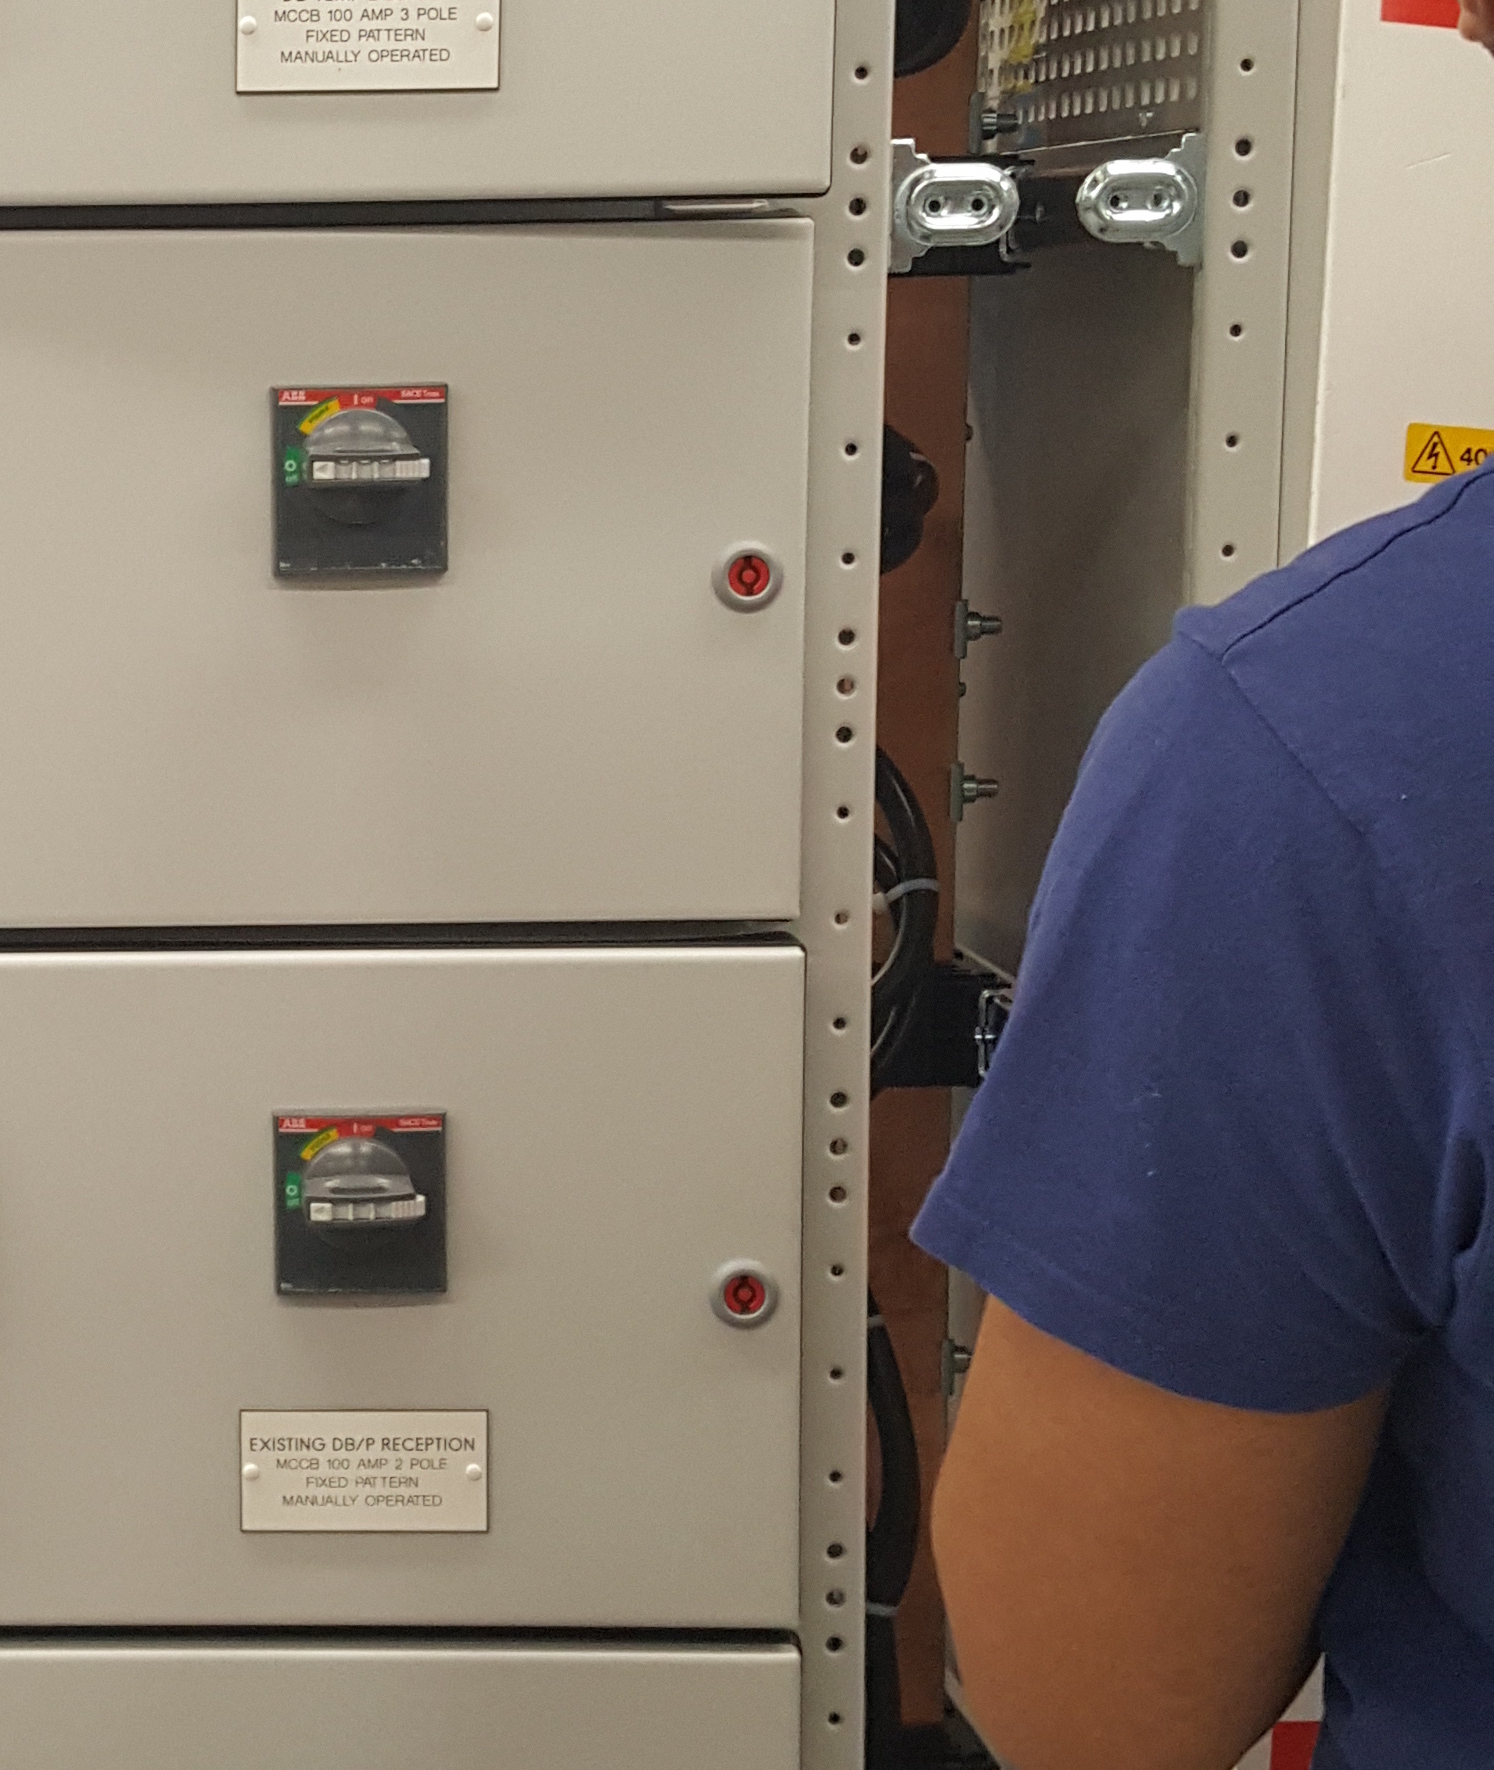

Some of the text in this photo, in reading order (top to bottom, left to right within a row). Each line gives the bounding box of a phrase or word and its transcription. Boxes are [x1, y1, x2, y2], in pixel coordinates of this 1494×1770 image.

[274, 7, 457, 23] MCCB 100 AMP 3 POLE
[306, 28, 426, 43] FIXED PATTERN
[280, 49, 450, 63] MANUALLY OPERATED
[250, 1437, 475, 1452] EXISTING DB/P RECEPTION
[276, 1458, 447, 1470] MCCB 100 AMP 2 POLE
[306, 1477, 418, 1489] FIXED PATTERN
[282, 1495, 442, 1506] MANUALLY OPERATED
